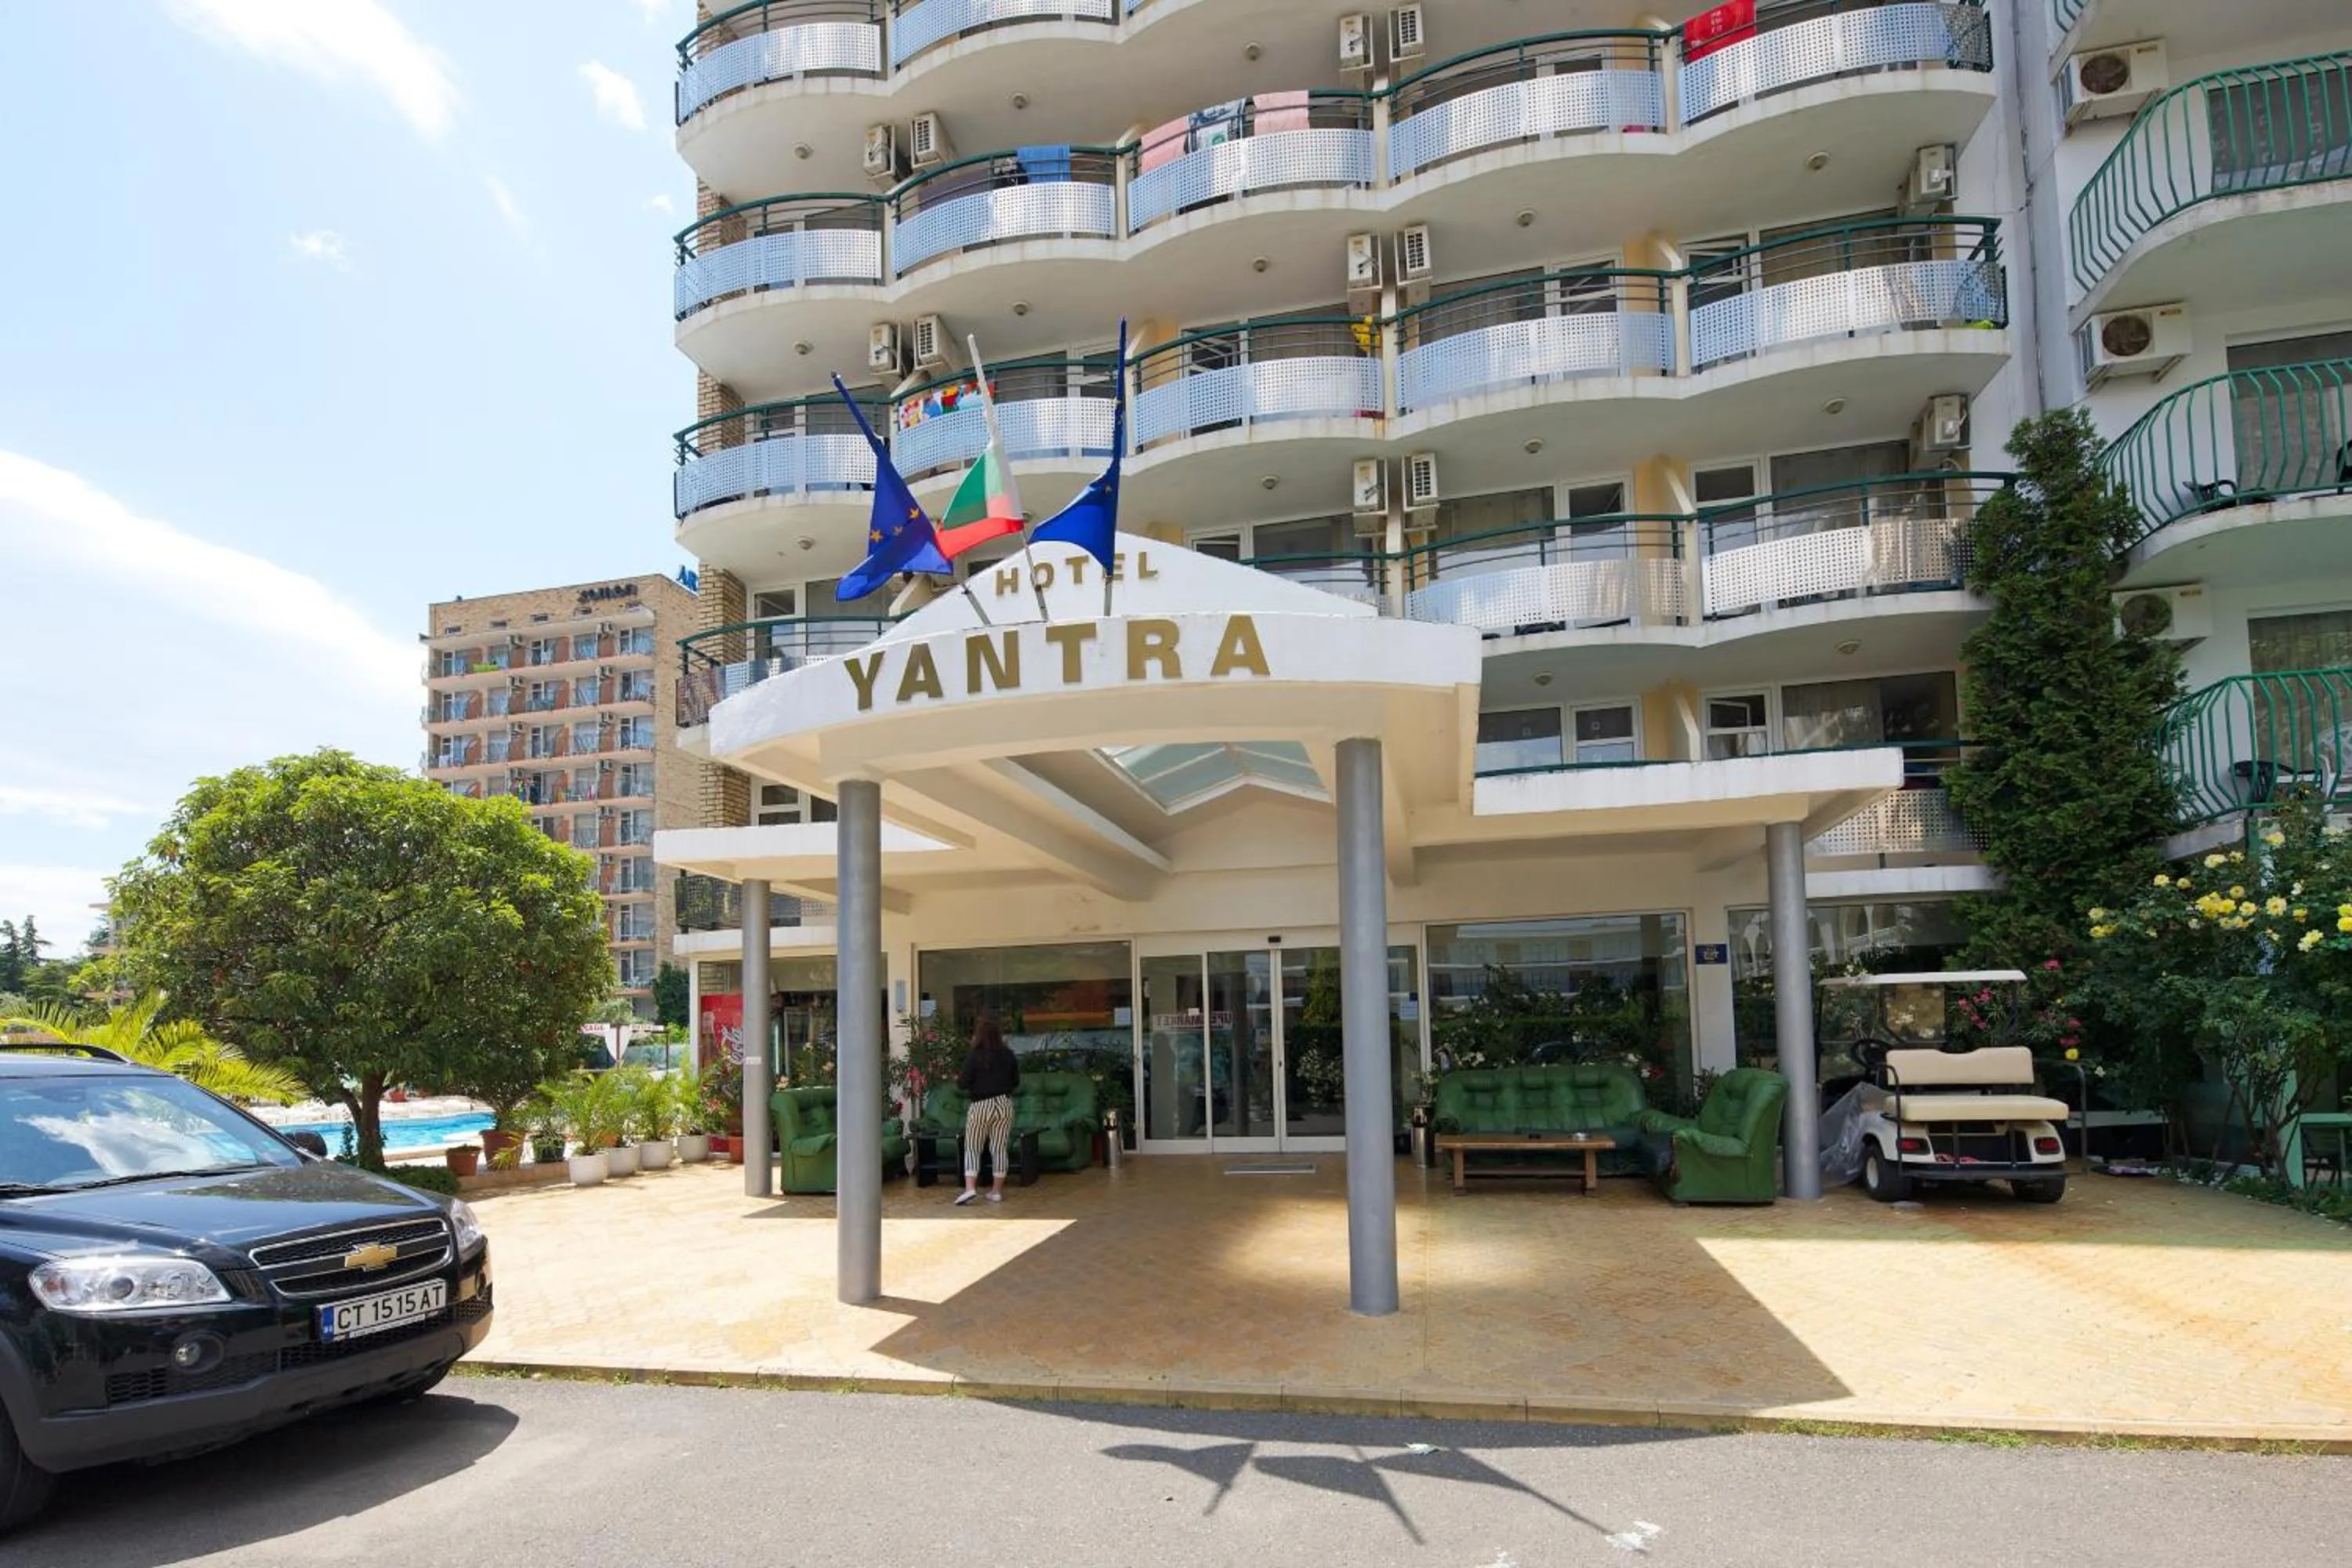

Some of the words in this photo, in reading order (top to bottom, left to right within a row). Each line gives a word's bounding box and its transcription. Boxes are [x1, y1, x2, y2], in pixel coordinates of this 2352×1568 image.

[995, 551, 1159, 597] HOTEL
[843, 614, 1272, 711] YANTRA
[337, 1304, 365, 1330] CT
[372, 1292, 416, 1321] 1515
[419, 1285, 443, 1311] AT
